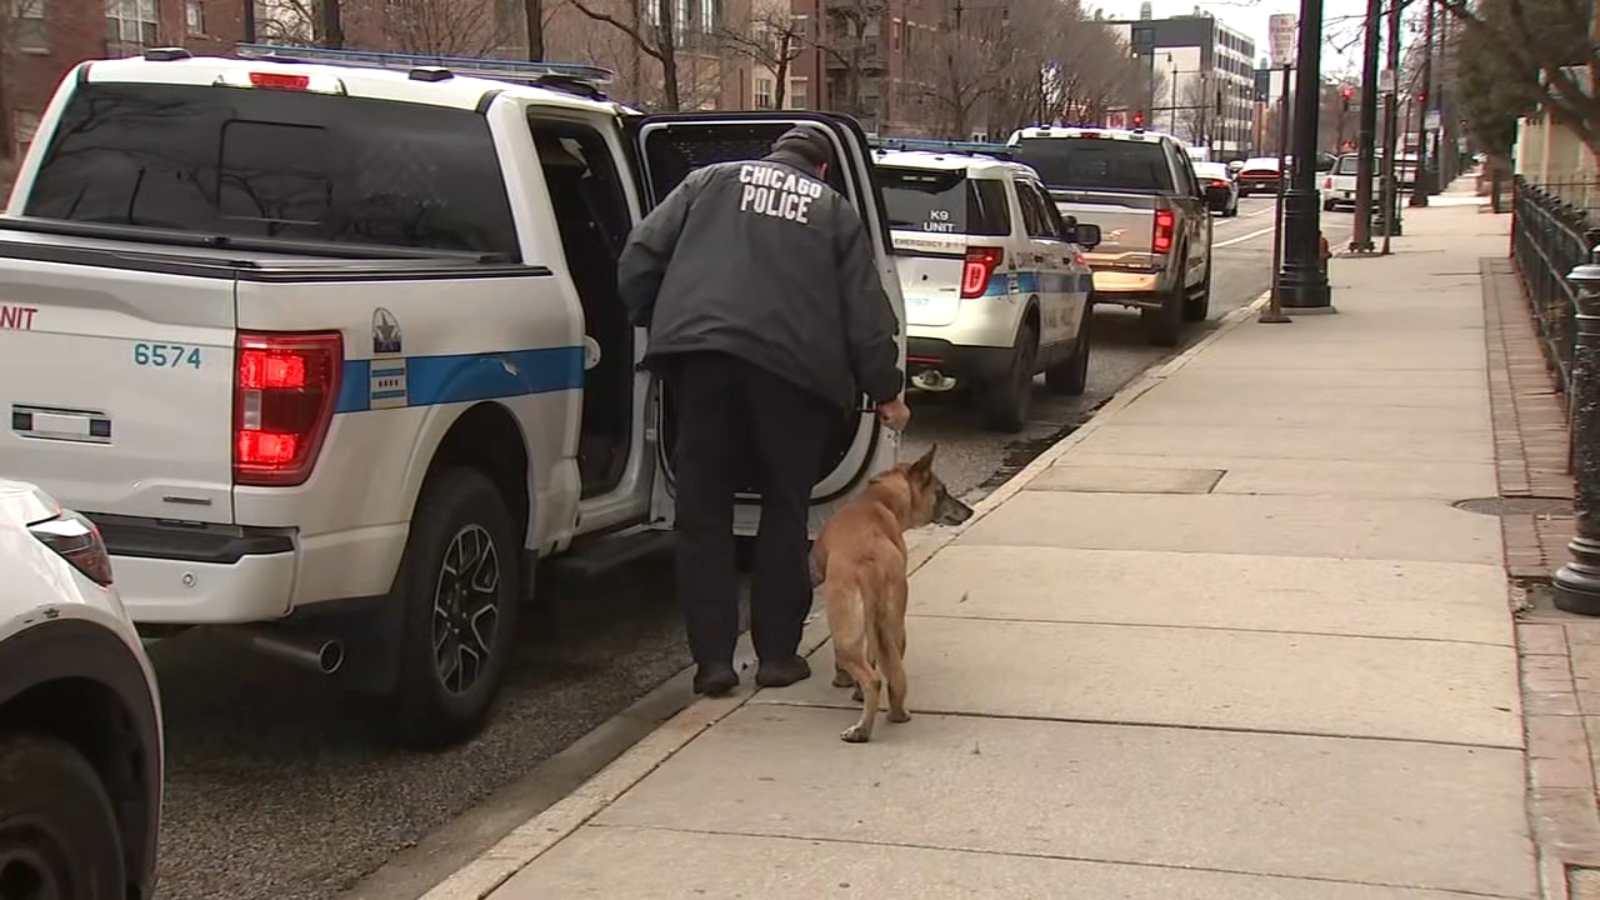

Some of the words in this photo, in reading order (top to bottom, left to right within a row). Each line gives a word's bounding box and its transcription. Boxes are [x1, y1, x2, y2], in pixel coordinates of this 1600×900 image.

[739, 165, 823, 199] CHICAGO
[740, 185, 812, 224] POLICE
[930, 210, 949, 220] K9
[924, 222, 955, 232] UNIT
[134, 343, 201, 369] 6574
